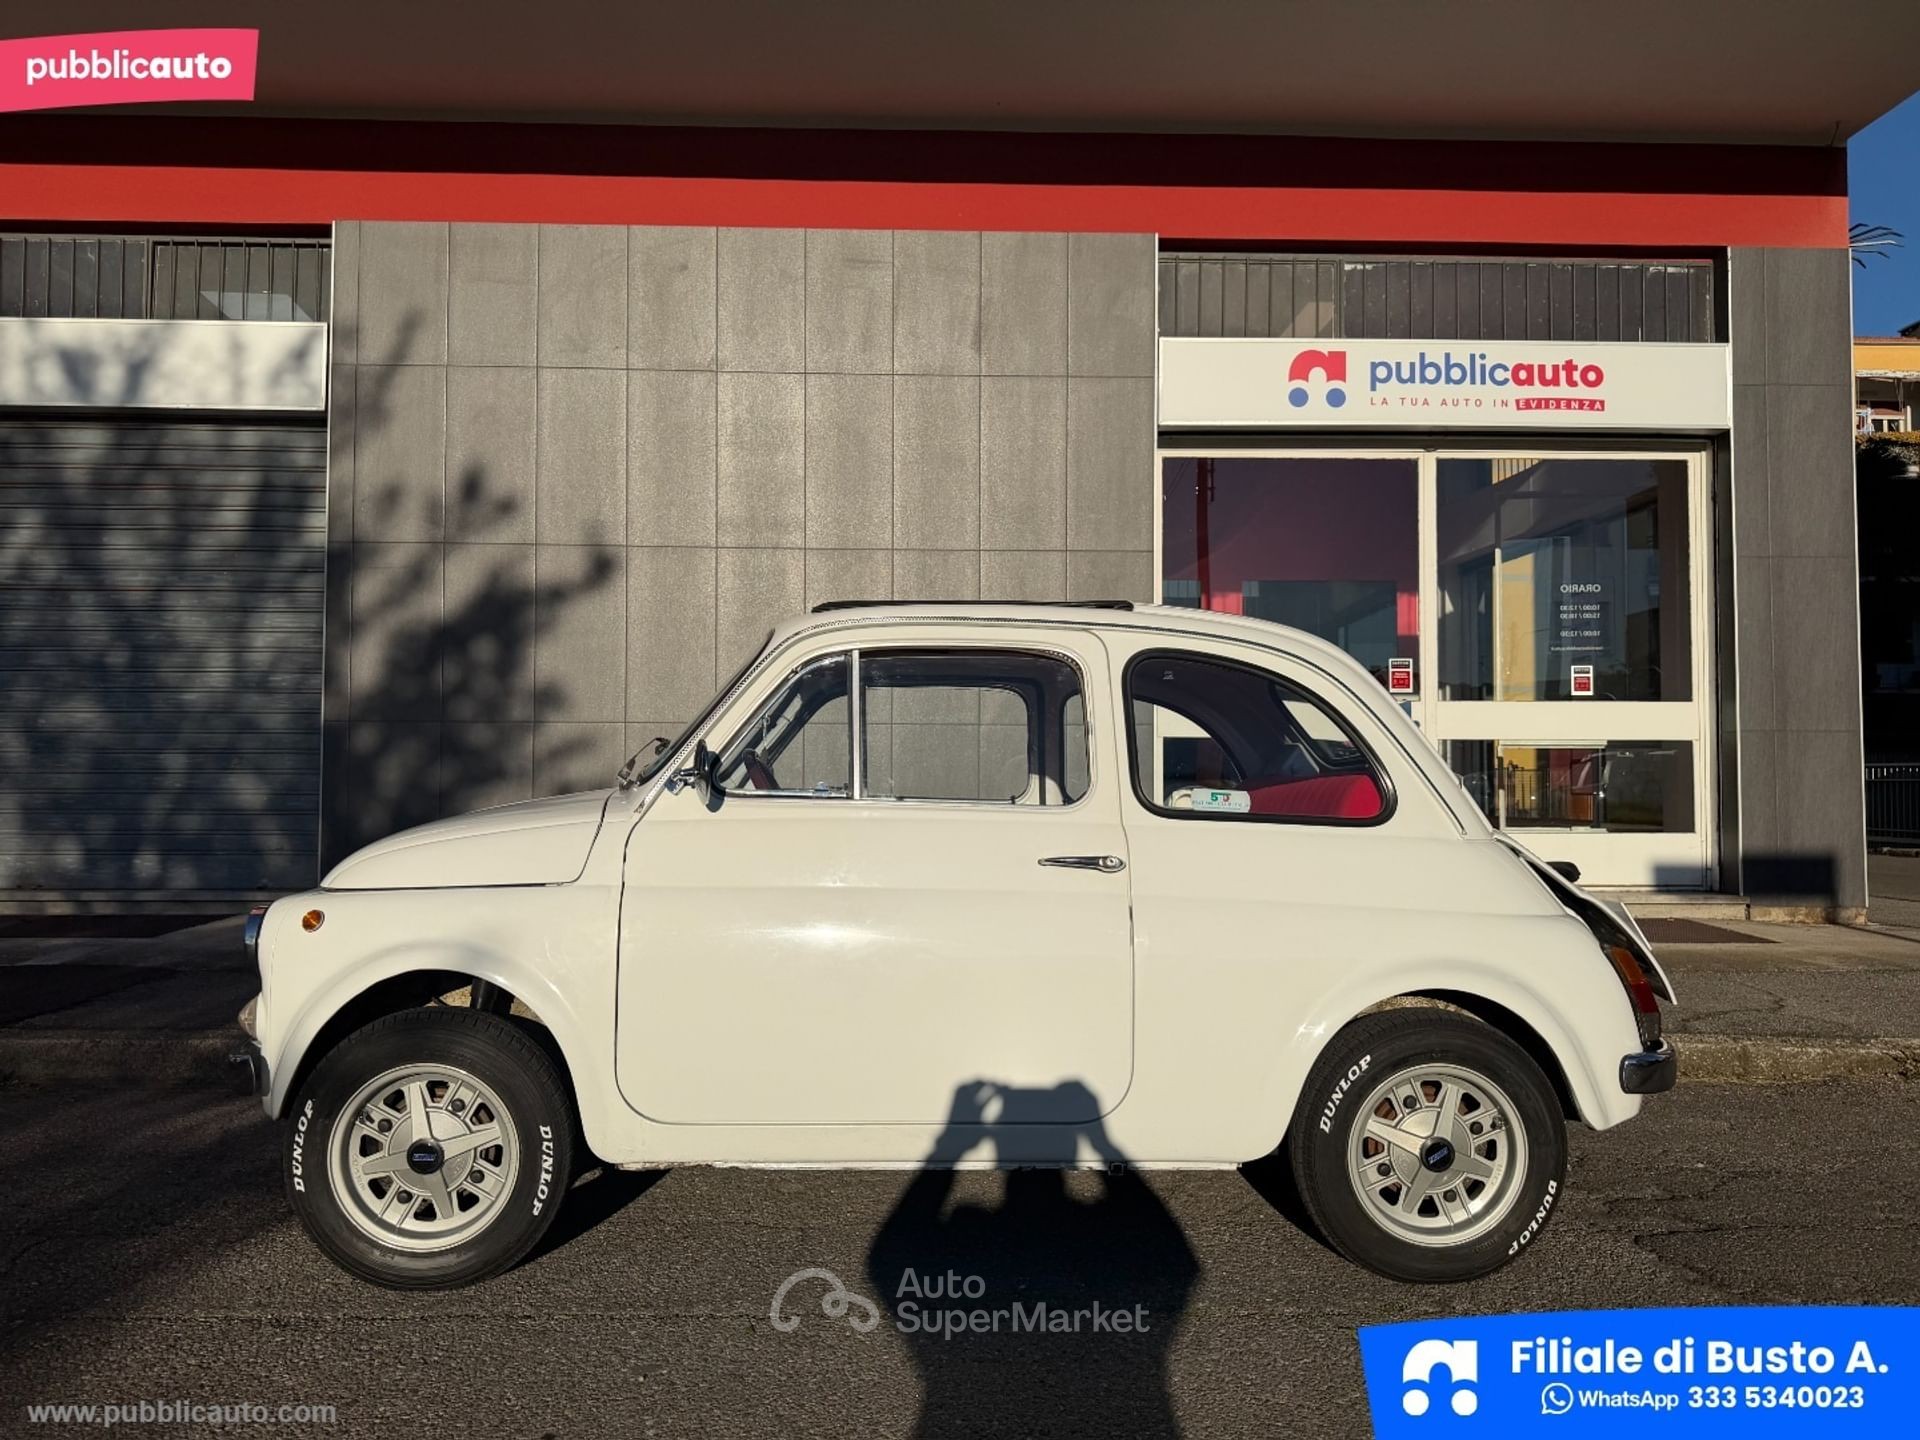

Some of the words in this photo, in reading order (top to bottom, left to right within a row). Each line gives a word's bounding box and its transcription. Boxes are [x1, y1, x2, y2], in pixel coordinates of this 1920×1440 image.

[1370, 352, 1604, 391] pubblicauto
[1370, 396, 1389, 406] LA
[1400, 397, 1430, 407] TUA
[1440, 398, 1483, 408] AUTO
[1493, 399, 1509, 408] IN
[1518, 399, 1603, 411] EVIDENZA
[1320, 1054, 1372, 1134] DUNLOP
[292, 1099, 315, 1193] DUNLOP
[533, 1124, 555, 1217] DUNLOP
[1508, 1179, 1558, 1255] DUNLOP
